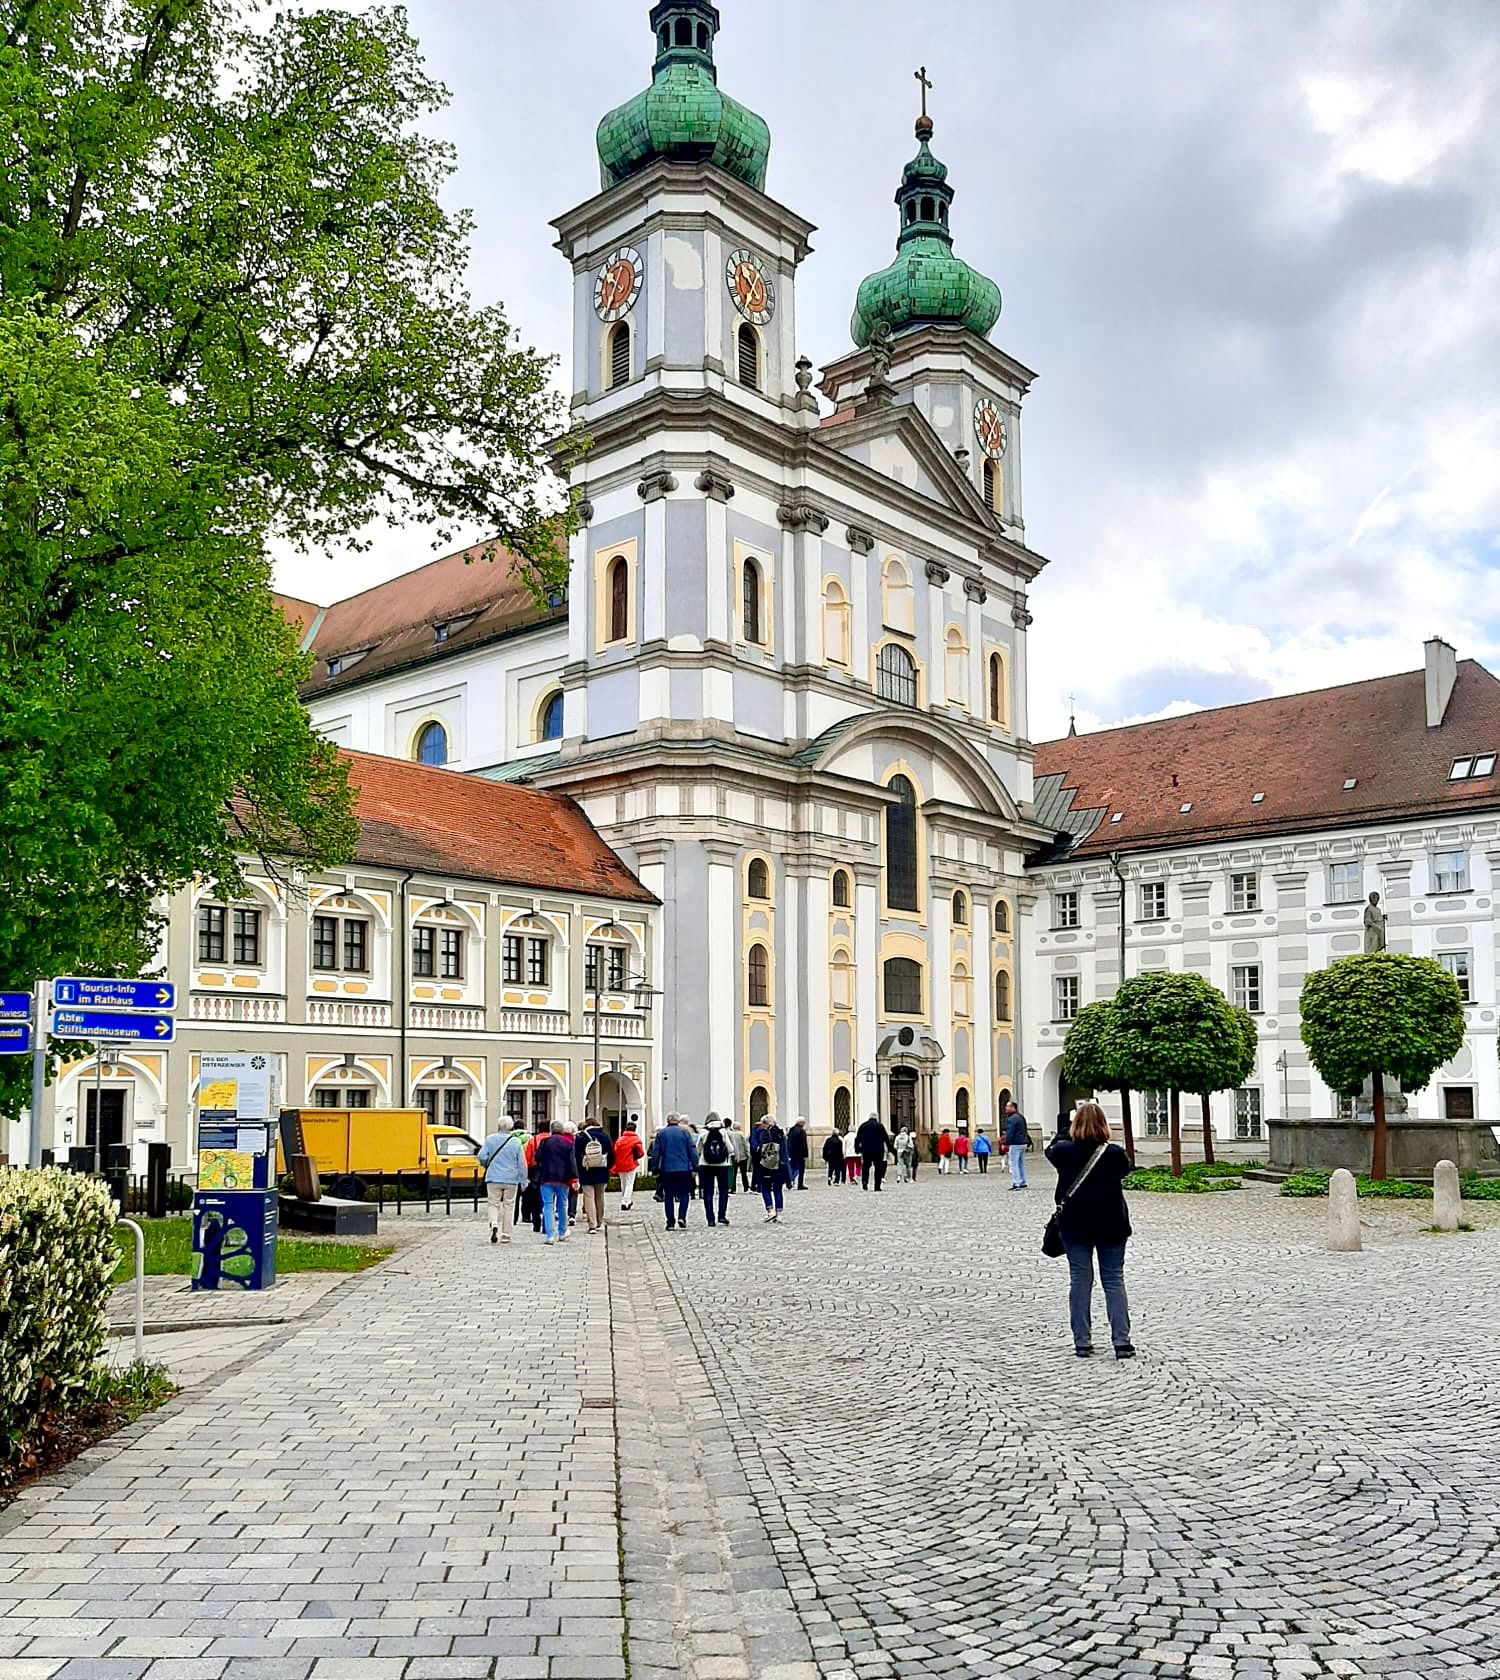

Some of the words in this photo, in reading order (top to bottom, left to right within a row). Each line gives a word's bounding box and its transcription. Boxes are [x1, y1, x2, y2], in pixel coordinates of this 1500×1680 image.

[79, 982, 137, 994] Tourist-Info
[78, 994, 91, 1004] im
[94, 994, 134, 1006] Rathaus
[58, 1012, 84, 1022] Abtei
[57, 1024, 141, 1037] Stiftlandmuseum
